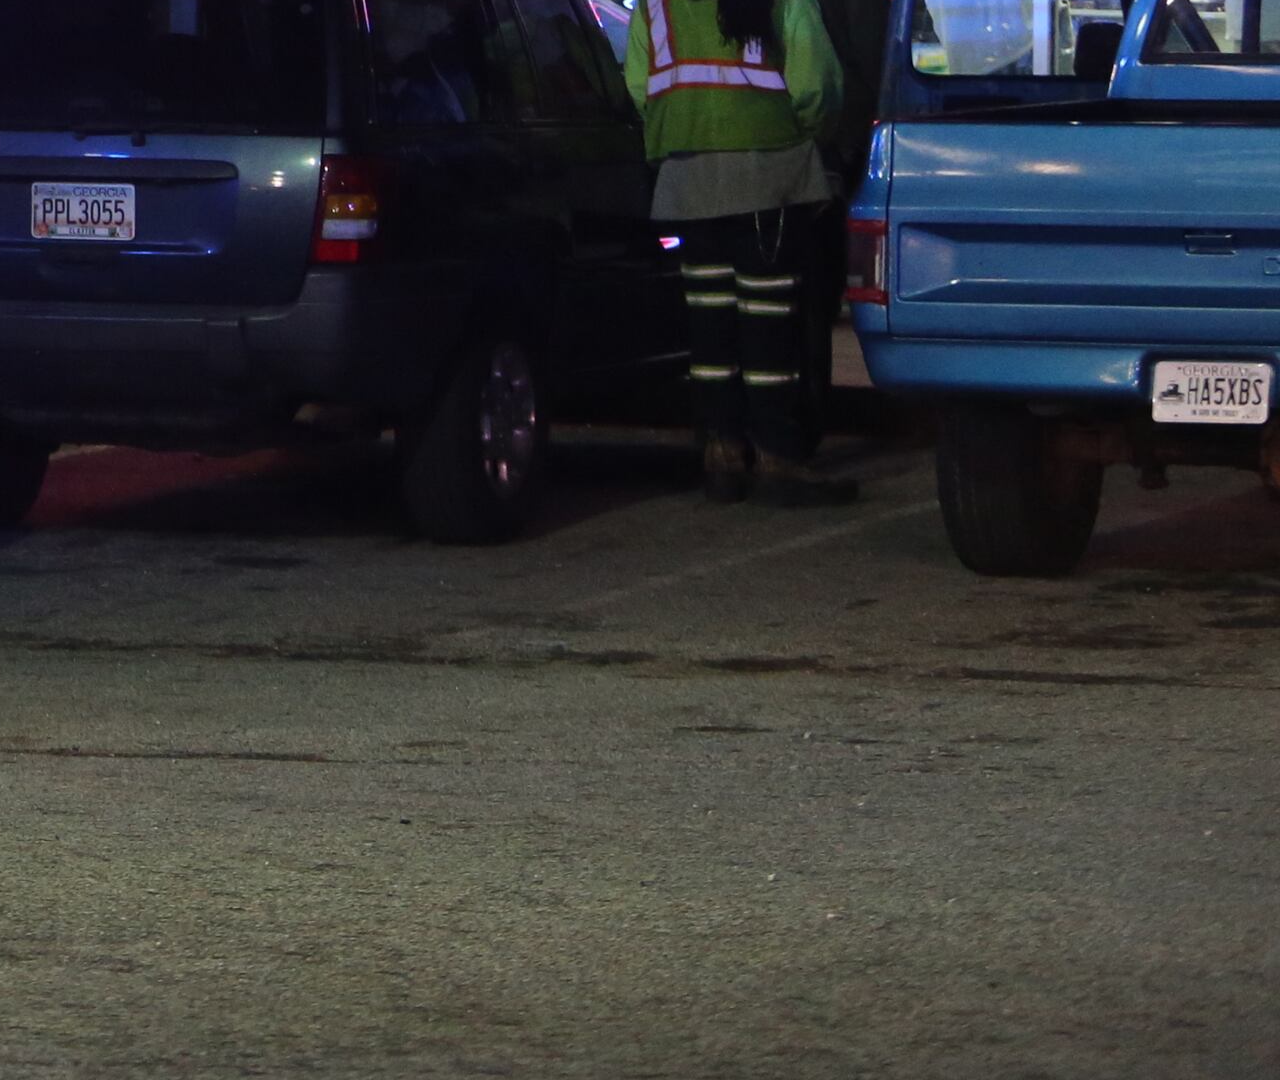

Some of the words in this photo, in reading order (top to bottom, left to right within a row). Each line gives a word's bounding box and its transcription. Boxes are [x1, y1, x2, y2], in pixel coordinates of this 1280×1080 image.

[72, 186, 128, 197] GEORGIA
[42, 198, 125, 226] PPL3055
[1182, 364, 1246, 377] GEORGIA
[1187, 377, 1264, 406] HA5XBS
